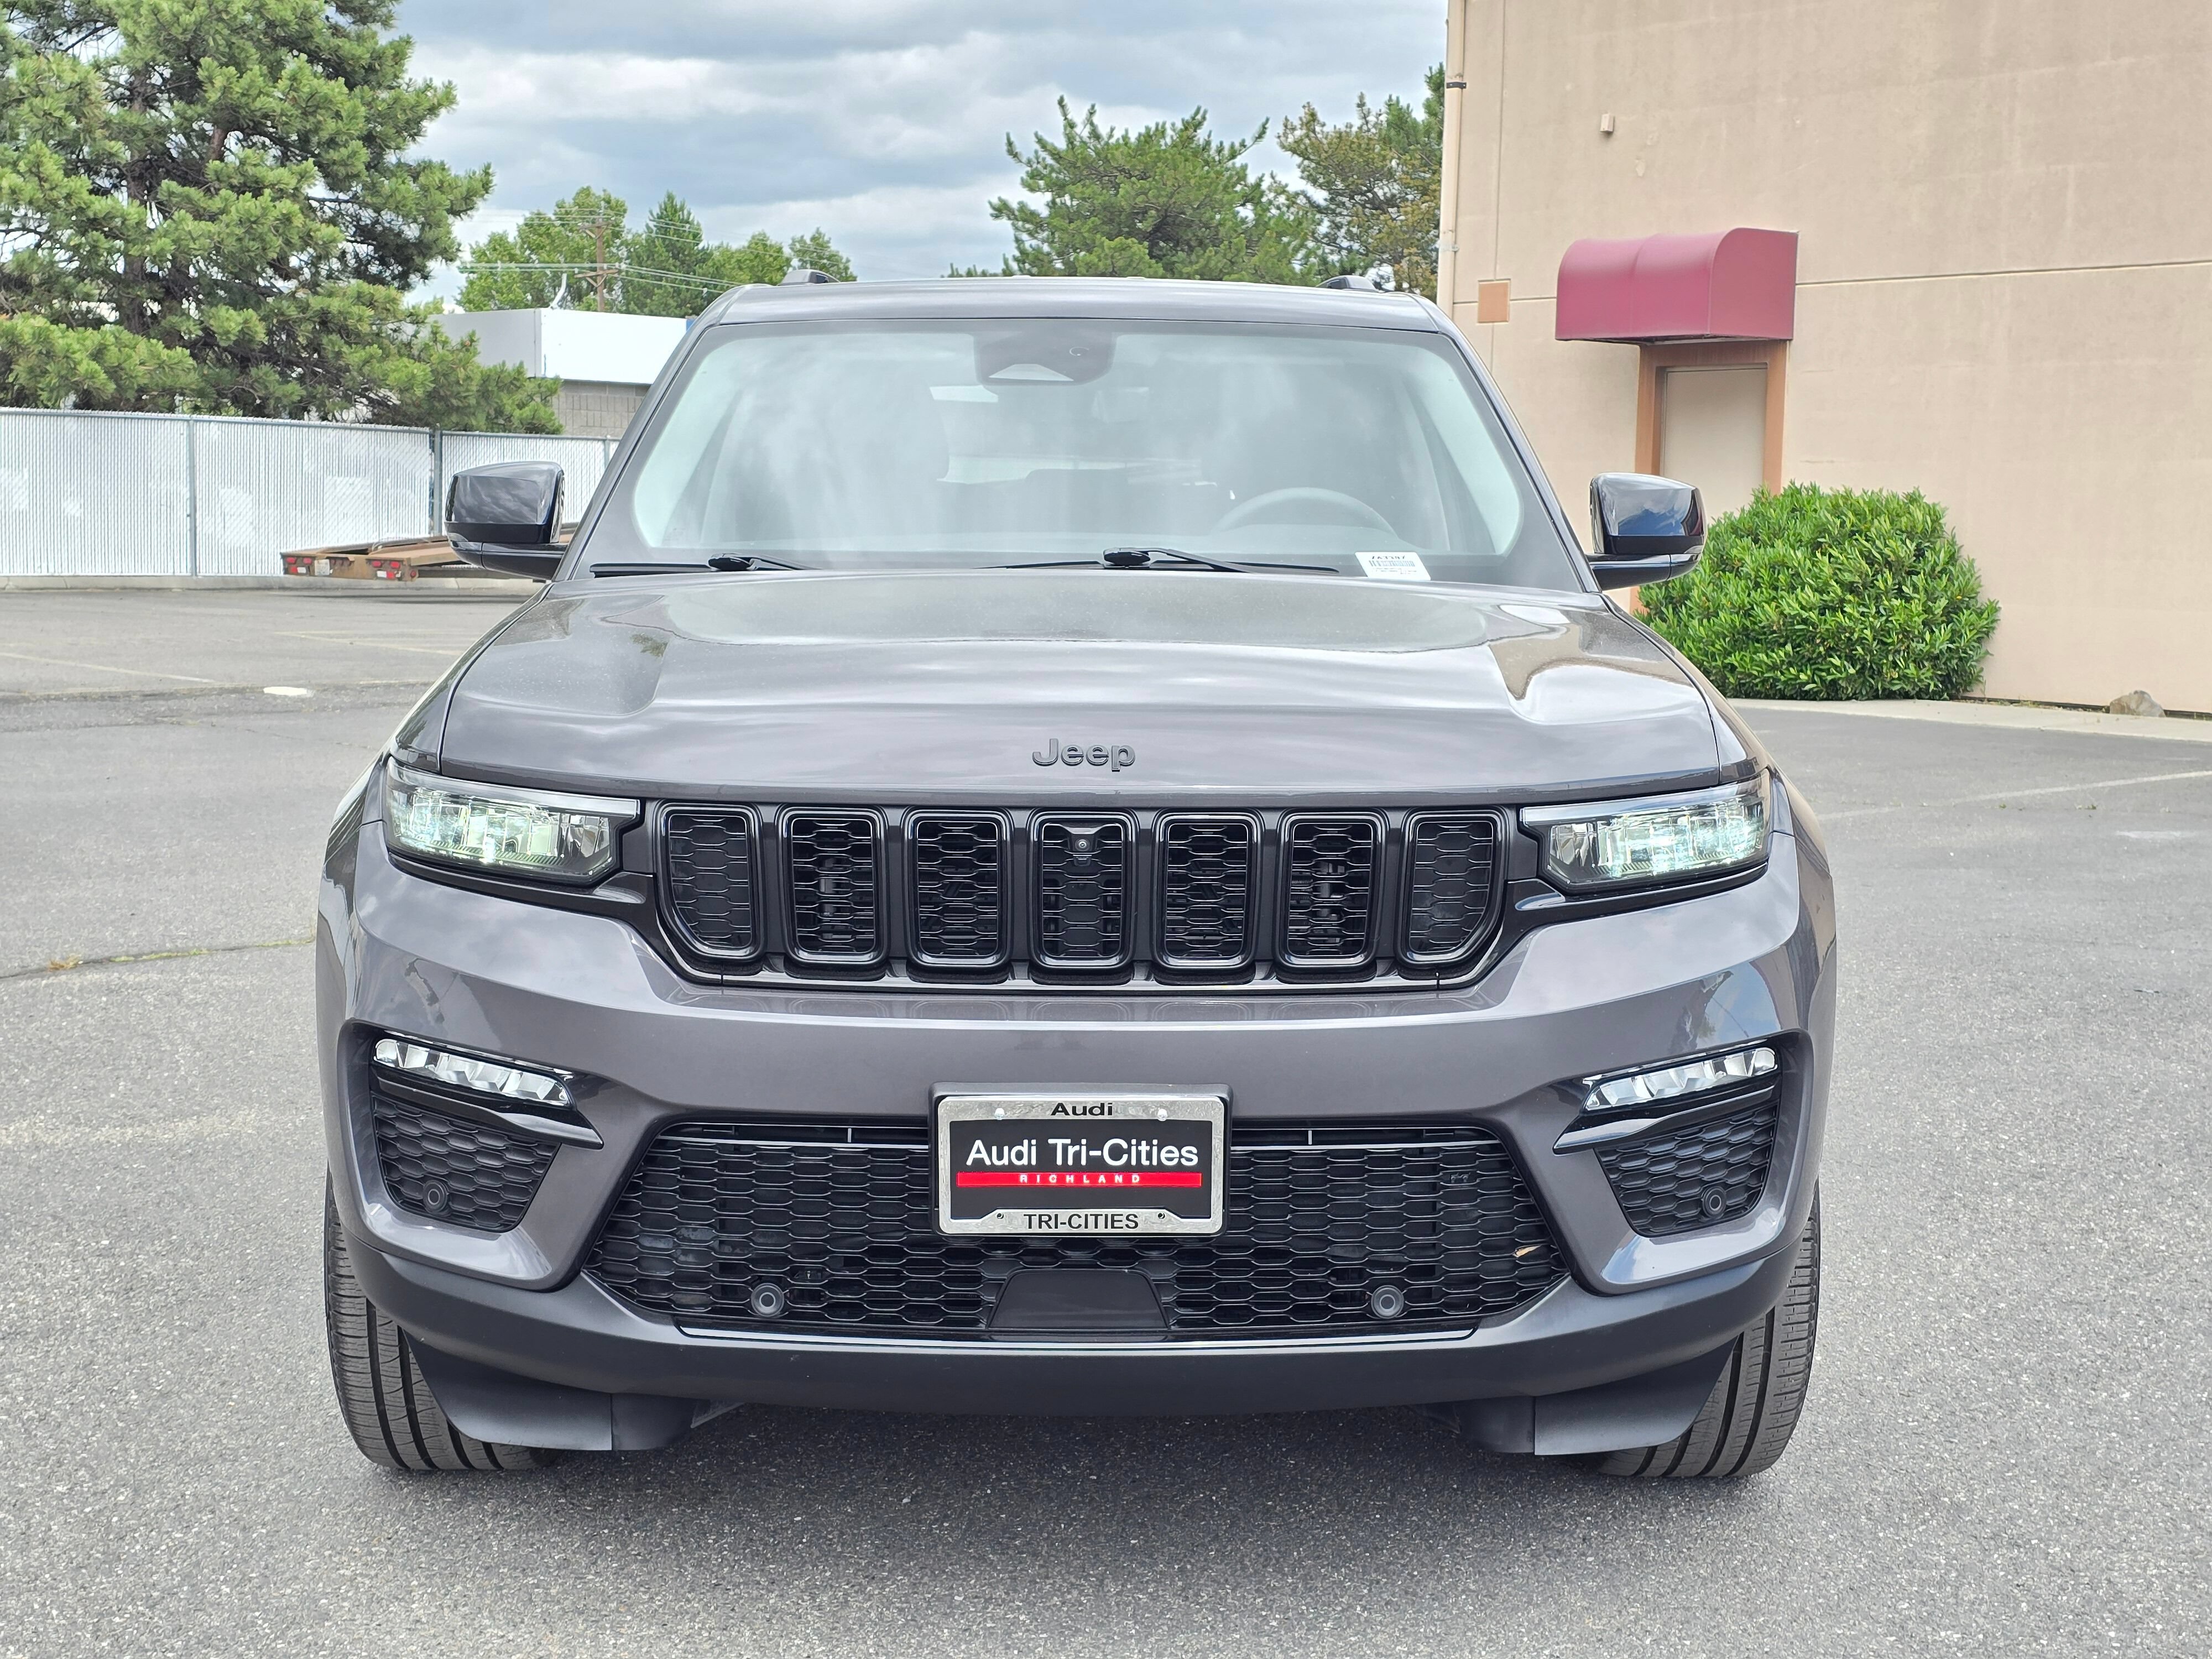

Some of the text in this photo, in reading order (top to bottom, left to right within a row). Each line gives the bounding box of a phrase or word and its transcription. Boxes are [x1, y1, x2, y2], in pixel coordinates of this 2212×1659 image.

[1032, 738, 1135, 772] Jeep
[1051, 1102, 1113, 1117] Audi
[966, 1138, 1198, 1166] Audi Tri-Cities
[1020, 1173, 1140, 1183] RICHLAND
[1023, 1213, 1139, 1229] TRI-CITIES
